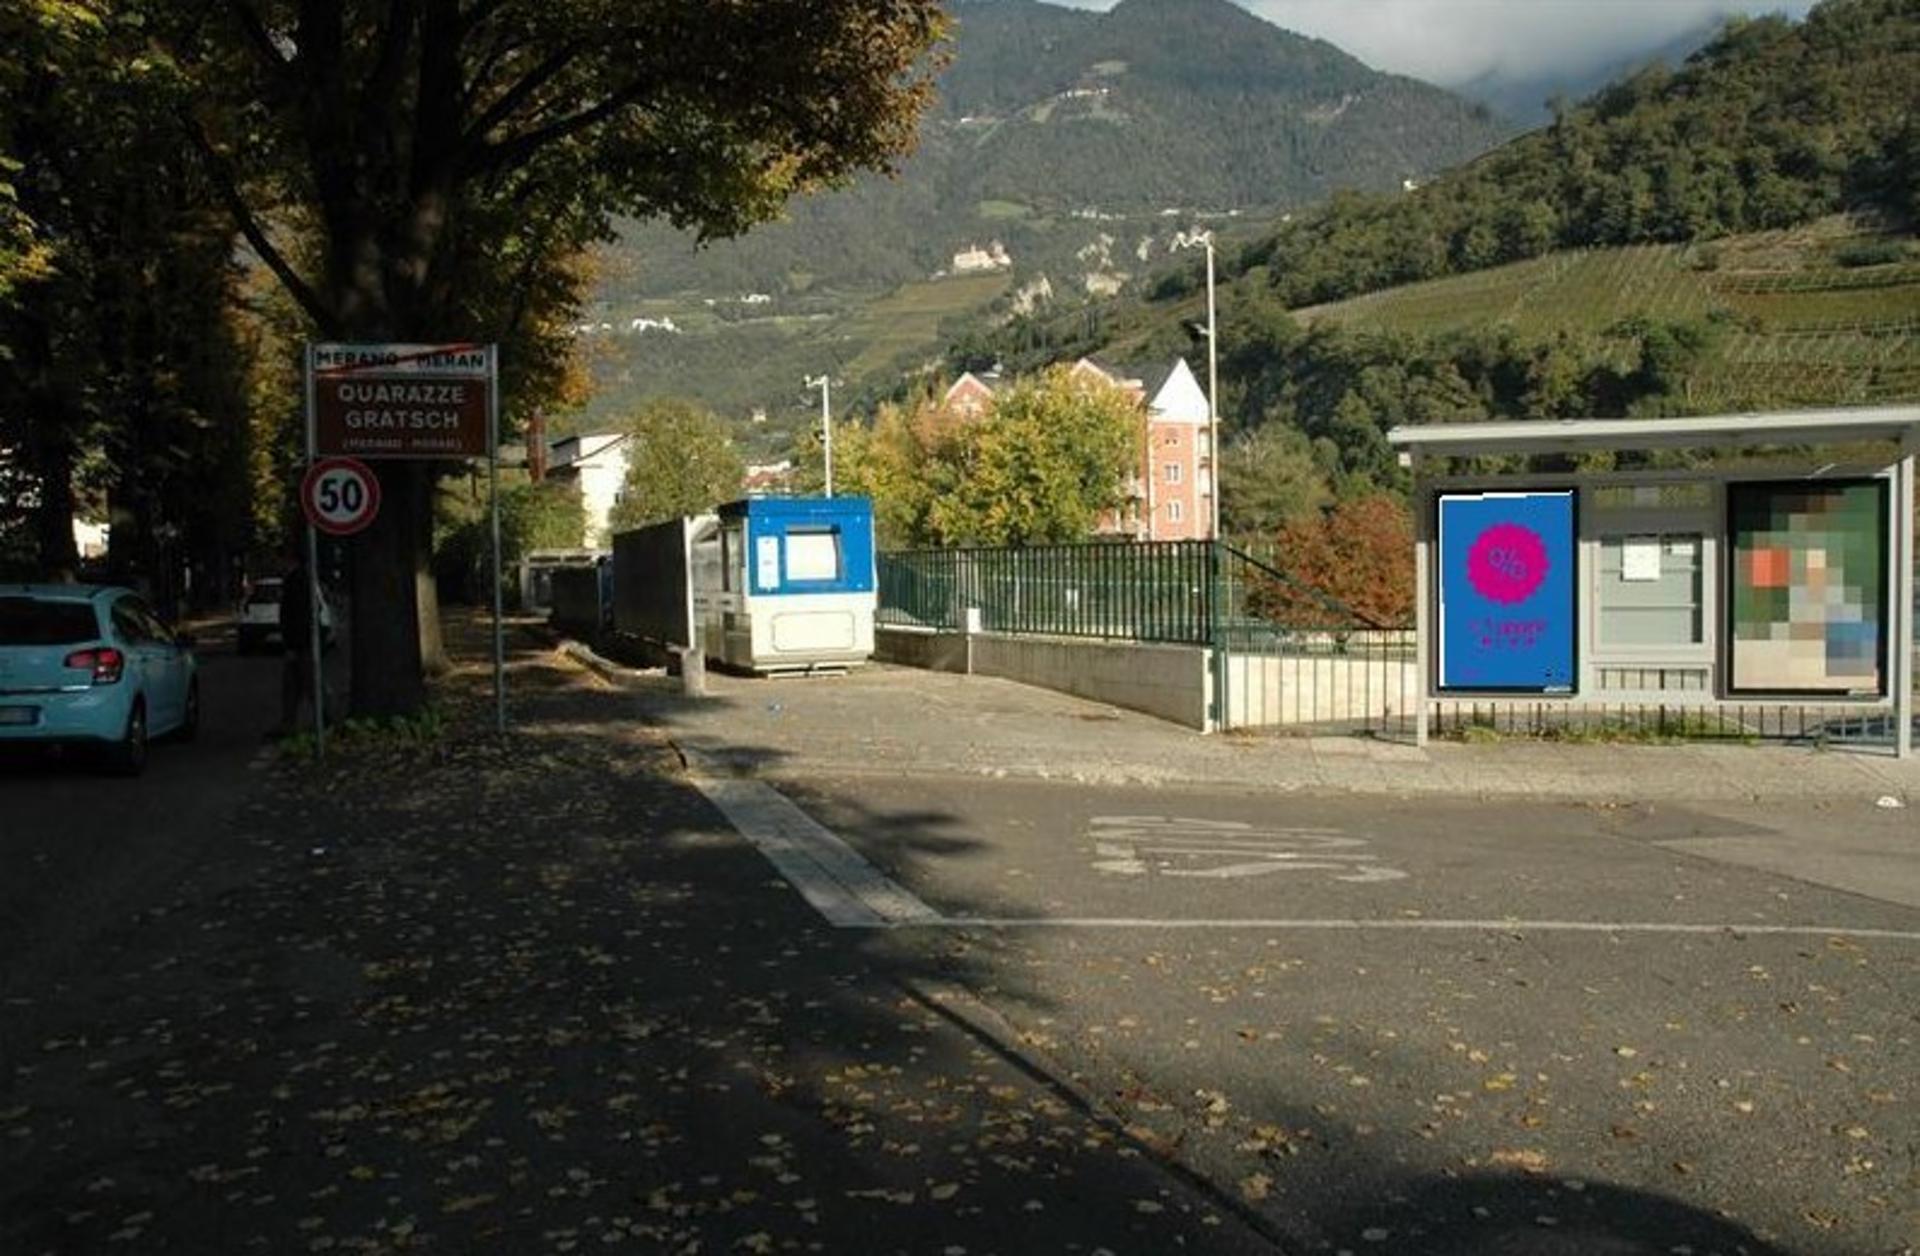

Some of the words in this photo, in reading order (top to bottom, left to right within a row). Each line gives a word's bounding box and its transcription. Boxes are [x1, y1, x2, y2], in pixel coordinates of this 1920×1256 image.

[338, 385, 464, 404] QUARAZZE
[346, 411, 459, 429] GRATSCH
[319, 478, 362, 512] 50
[1087, 814, 1411, 883] STOP
